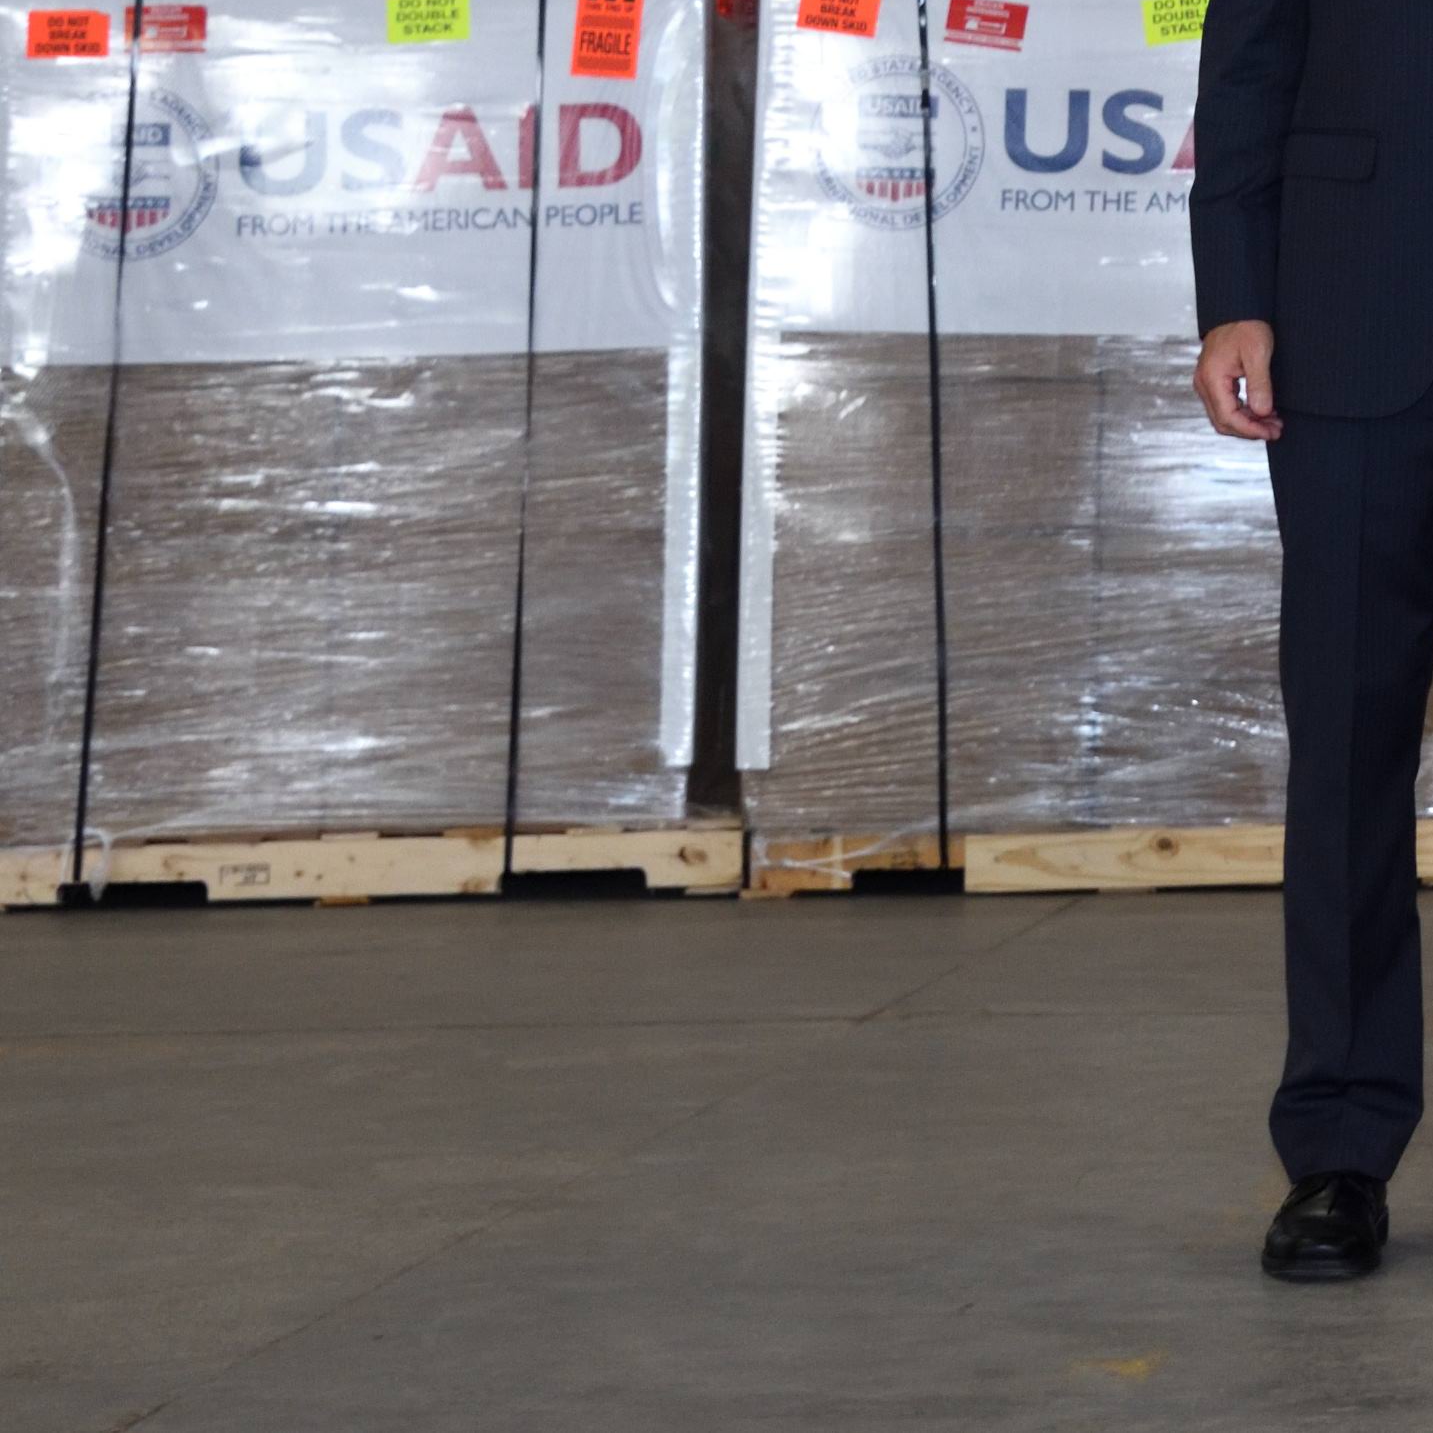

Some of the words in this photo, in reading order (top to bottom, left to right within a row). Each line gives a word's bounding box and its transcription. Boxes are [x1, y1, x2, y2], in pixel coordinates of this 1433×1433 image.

[820, 3, 856, 17] BREAK
[1154, 0, 1175, 11] DO
[48, 16, 65, 27] DO
[68, 15, 90, 27] NOT
[396, 9, 458, 23] DOUBLE
[805, 14, 839, 28] DOWN
[842, 18, 867, 32] SKID
[1153, 9, 1204, 24] DOUBL
[49, 30, 87, 40] BREAK
[403, 23, 452, 36] STACK
[580, 30, 631, 56] FRAGILE
[238, 102, 644, 197] USAID
[1000, 188, 1075, 212] FROM
[1084, 190, 1137, 212] THE
[236, 212, 314, 237] FROM
[388, 206, 534, 233] AMERICAN
[545, 201, 643, 228] PEOPLE
